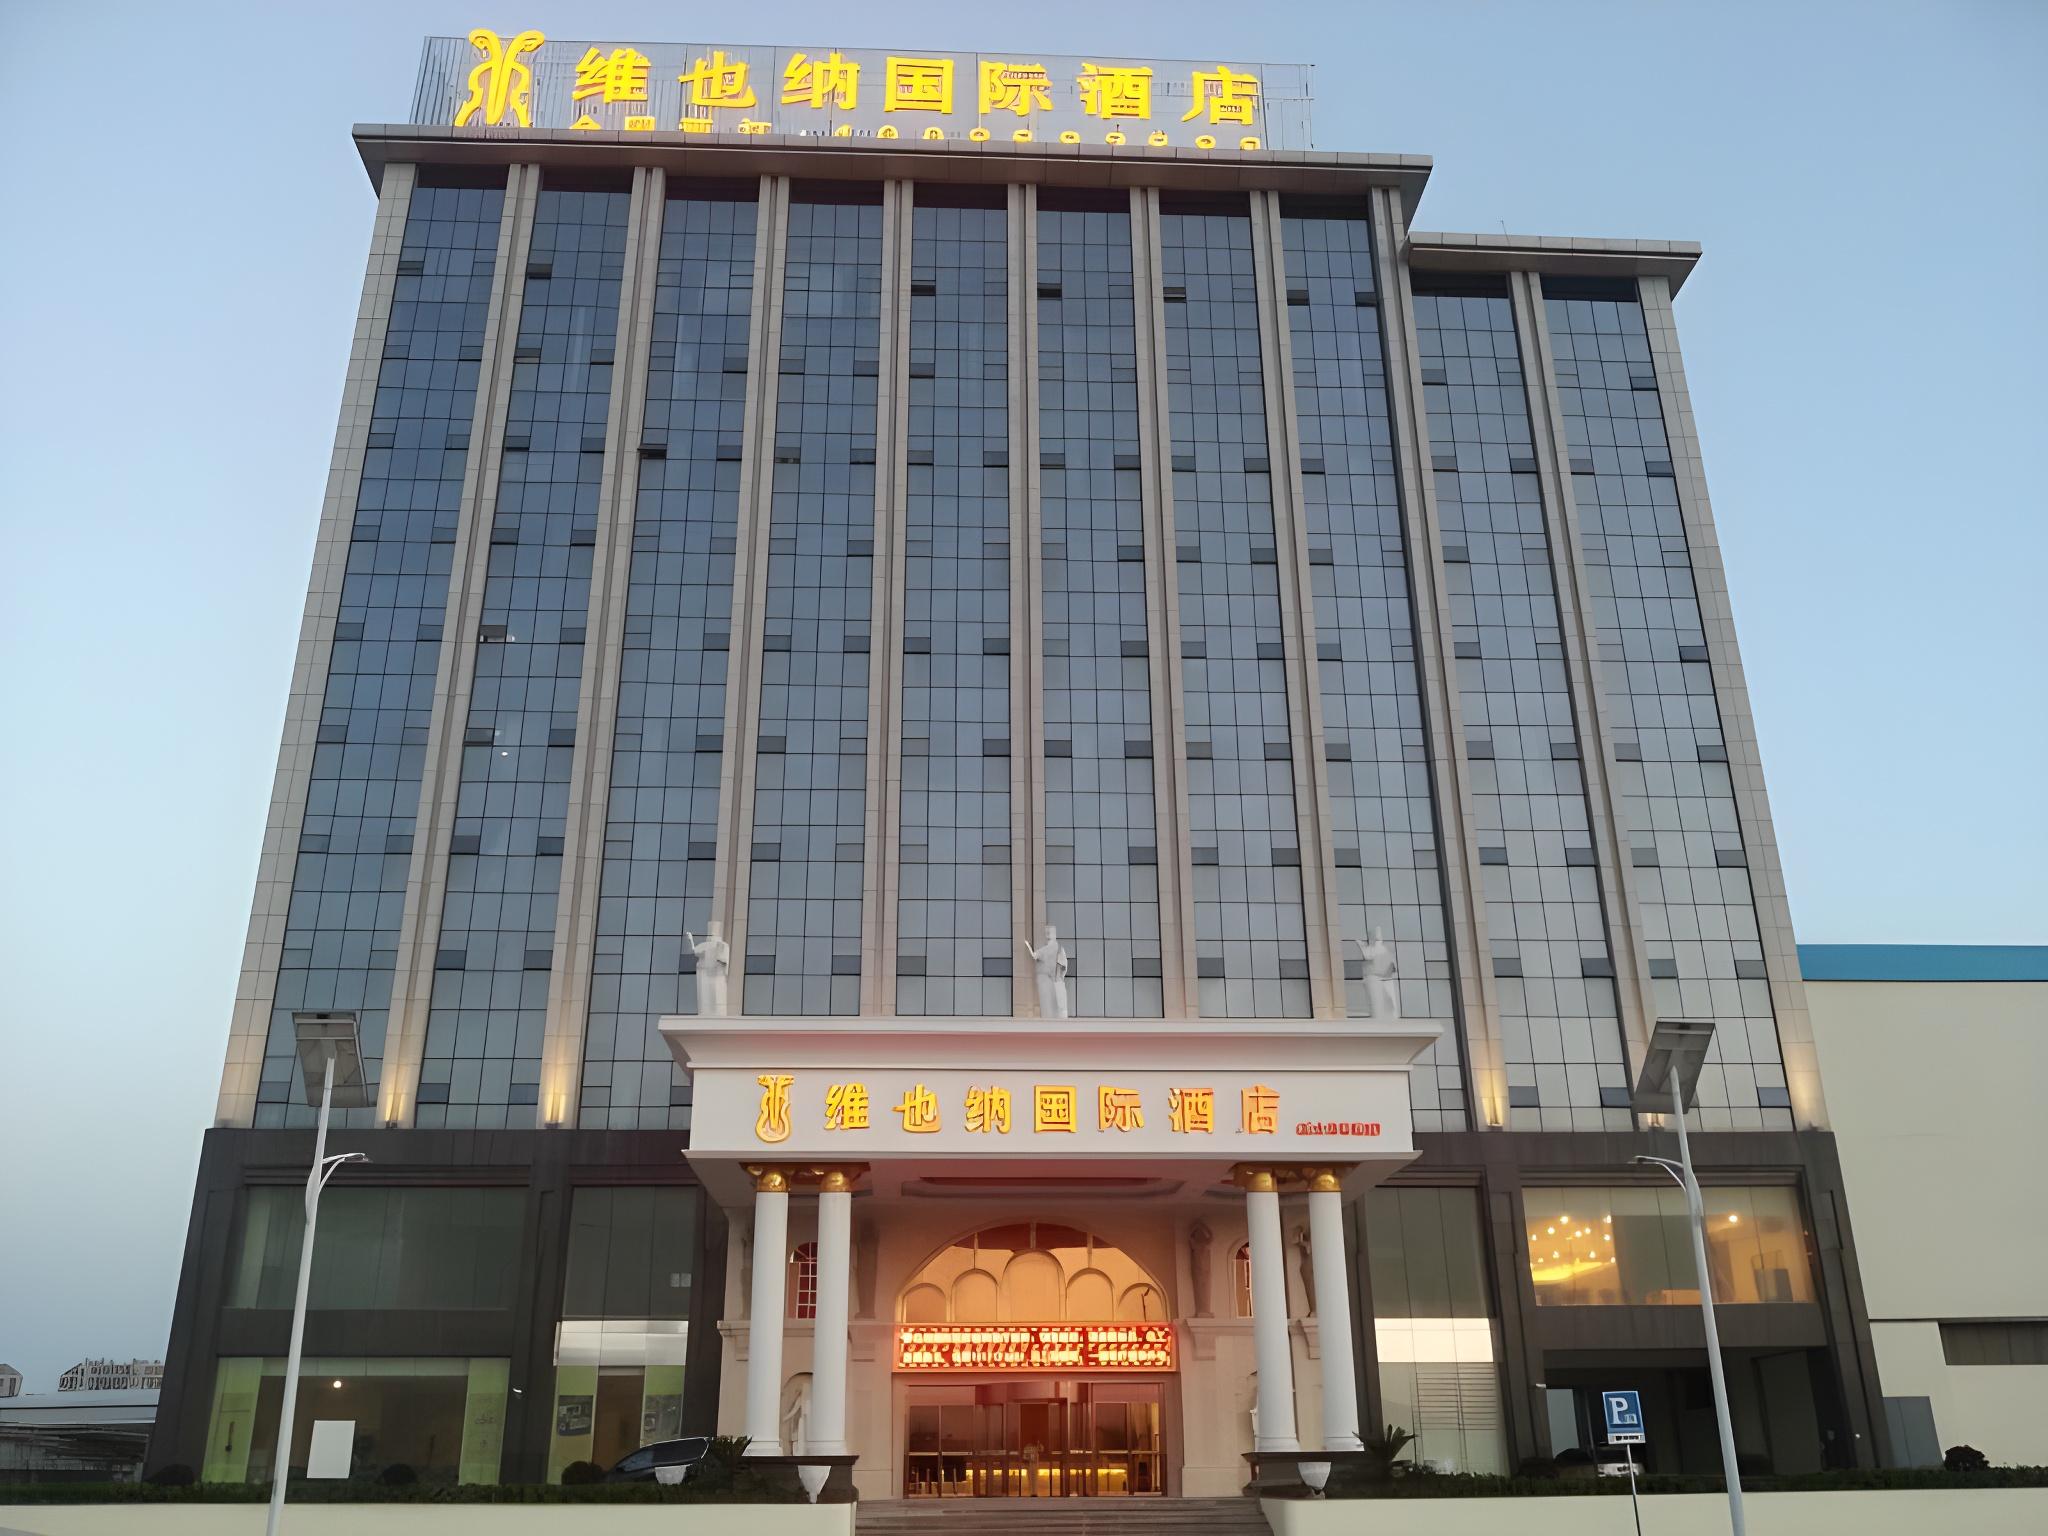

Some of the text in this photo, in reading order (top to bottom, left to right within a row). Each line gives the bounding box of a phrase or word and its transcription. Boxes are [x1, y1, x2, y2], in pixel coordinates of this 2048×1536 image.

[572, 46, 1260, 125] 维也纳国际酒店
[824, 1084, 1281, 1135] 维也纳国际酒店
